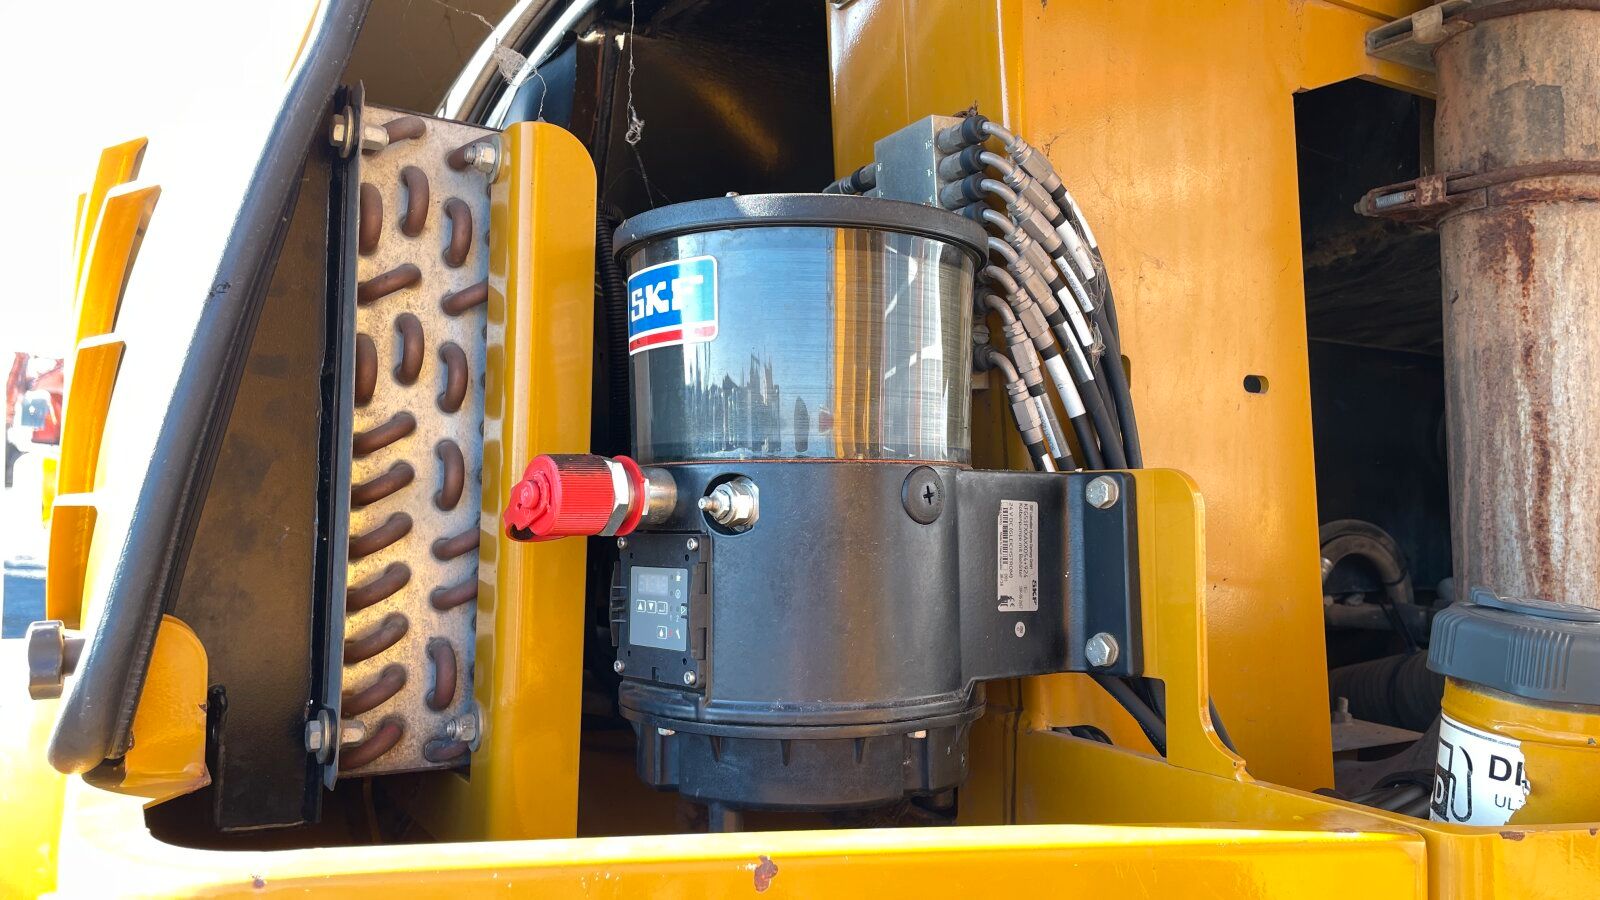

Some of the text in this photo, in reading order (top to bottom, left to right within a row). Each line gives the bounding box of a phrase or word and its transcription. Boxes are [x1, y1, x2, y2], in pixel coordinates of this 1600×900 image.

[631, 275, 704, 323] SKF
[1488, 754, 1524, 787] DI
[1494, 794, 1522, 811] UL
